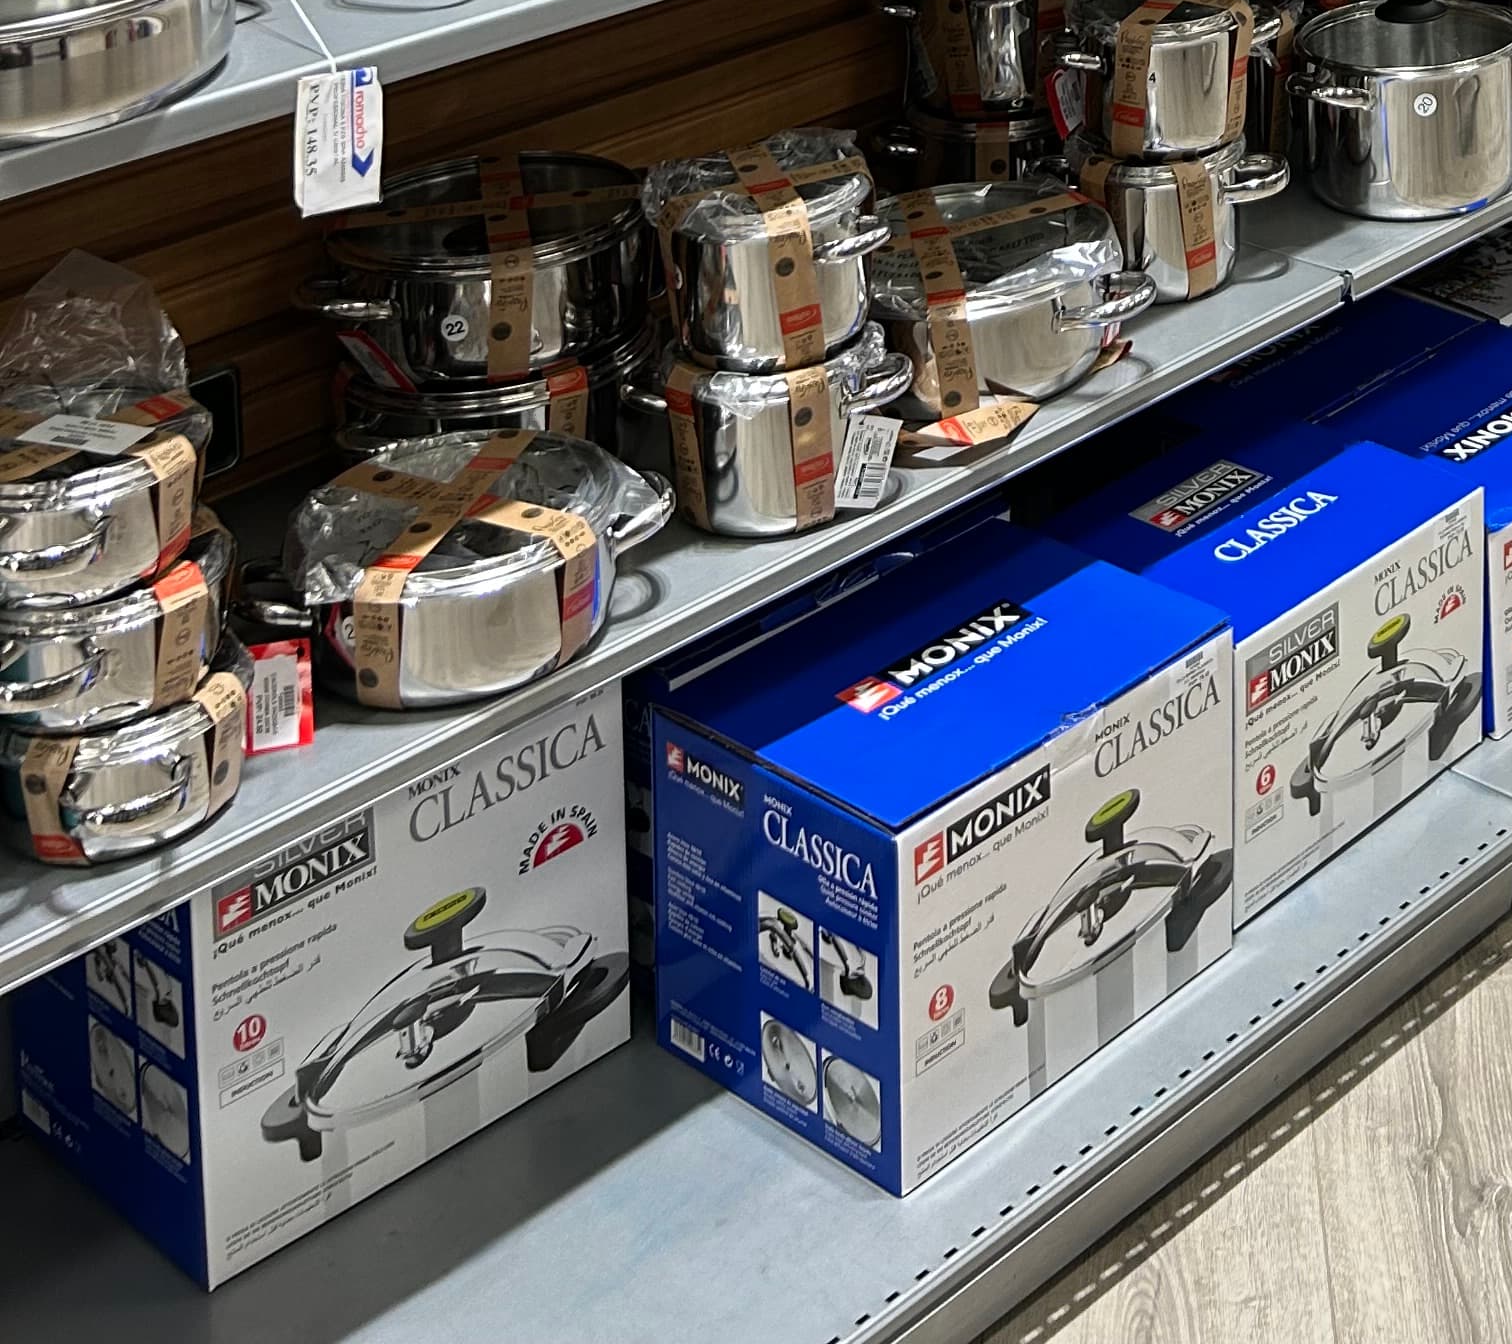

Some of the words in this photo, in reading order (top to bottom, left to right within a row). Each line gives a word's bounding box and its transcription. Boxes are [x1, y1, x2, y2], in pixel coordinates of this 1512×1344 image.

[1417, 96, 1434, 114] 20
[445, 320, 466, 336] 22
[1156, 463, 1233, 506] SILVER
[1177, 469, 1253, 516] MONIX
[1214, 491, 1339, 561] CLASSICA
[1374, 560, 1401, 585] MONIX
[1374, 530, 1473, 616] CLASSICA
[888, 604, 1021, 688] MONIX
[973, 642, 1003, 666] que
[1003, 616, 1050, 649] Monix!
[1269, 609, 1337, 665] SILVER
[1271, 630, 1337, 693] MONIX
[1094, 674, 1221, 778] CLASSICA
[1095, 712, 1131, 743] MONIX
[408, 762, 462, 801] MONIX
[409, 713, 608, 844] CLASSICA
[686, 757, 741, 801] MONIX
[763, 794, 793, 817] MONIX
[951, 773, 1044, 855] MONIX
[992, 830, 1014, 854] que
[1014, 806, 1050, 835] Monix!
[253, 812, 367, 879] SILVER
[518, 822, 547, 876] MADE
[550, 807, 568, 826] IN
[570, 804, 598, 841] SPAIN
[763, 809, 879, 900] CLASSICA
[255, 834, 368, 912] MONIX
[212, 933, 246, 961] ¡Qué
[307, 889, 332, 912] que
[334, 866, 378, 895] Monix!
[936, 987, 948, 1010] 8
[237, 1017, 261, 1043] 10
